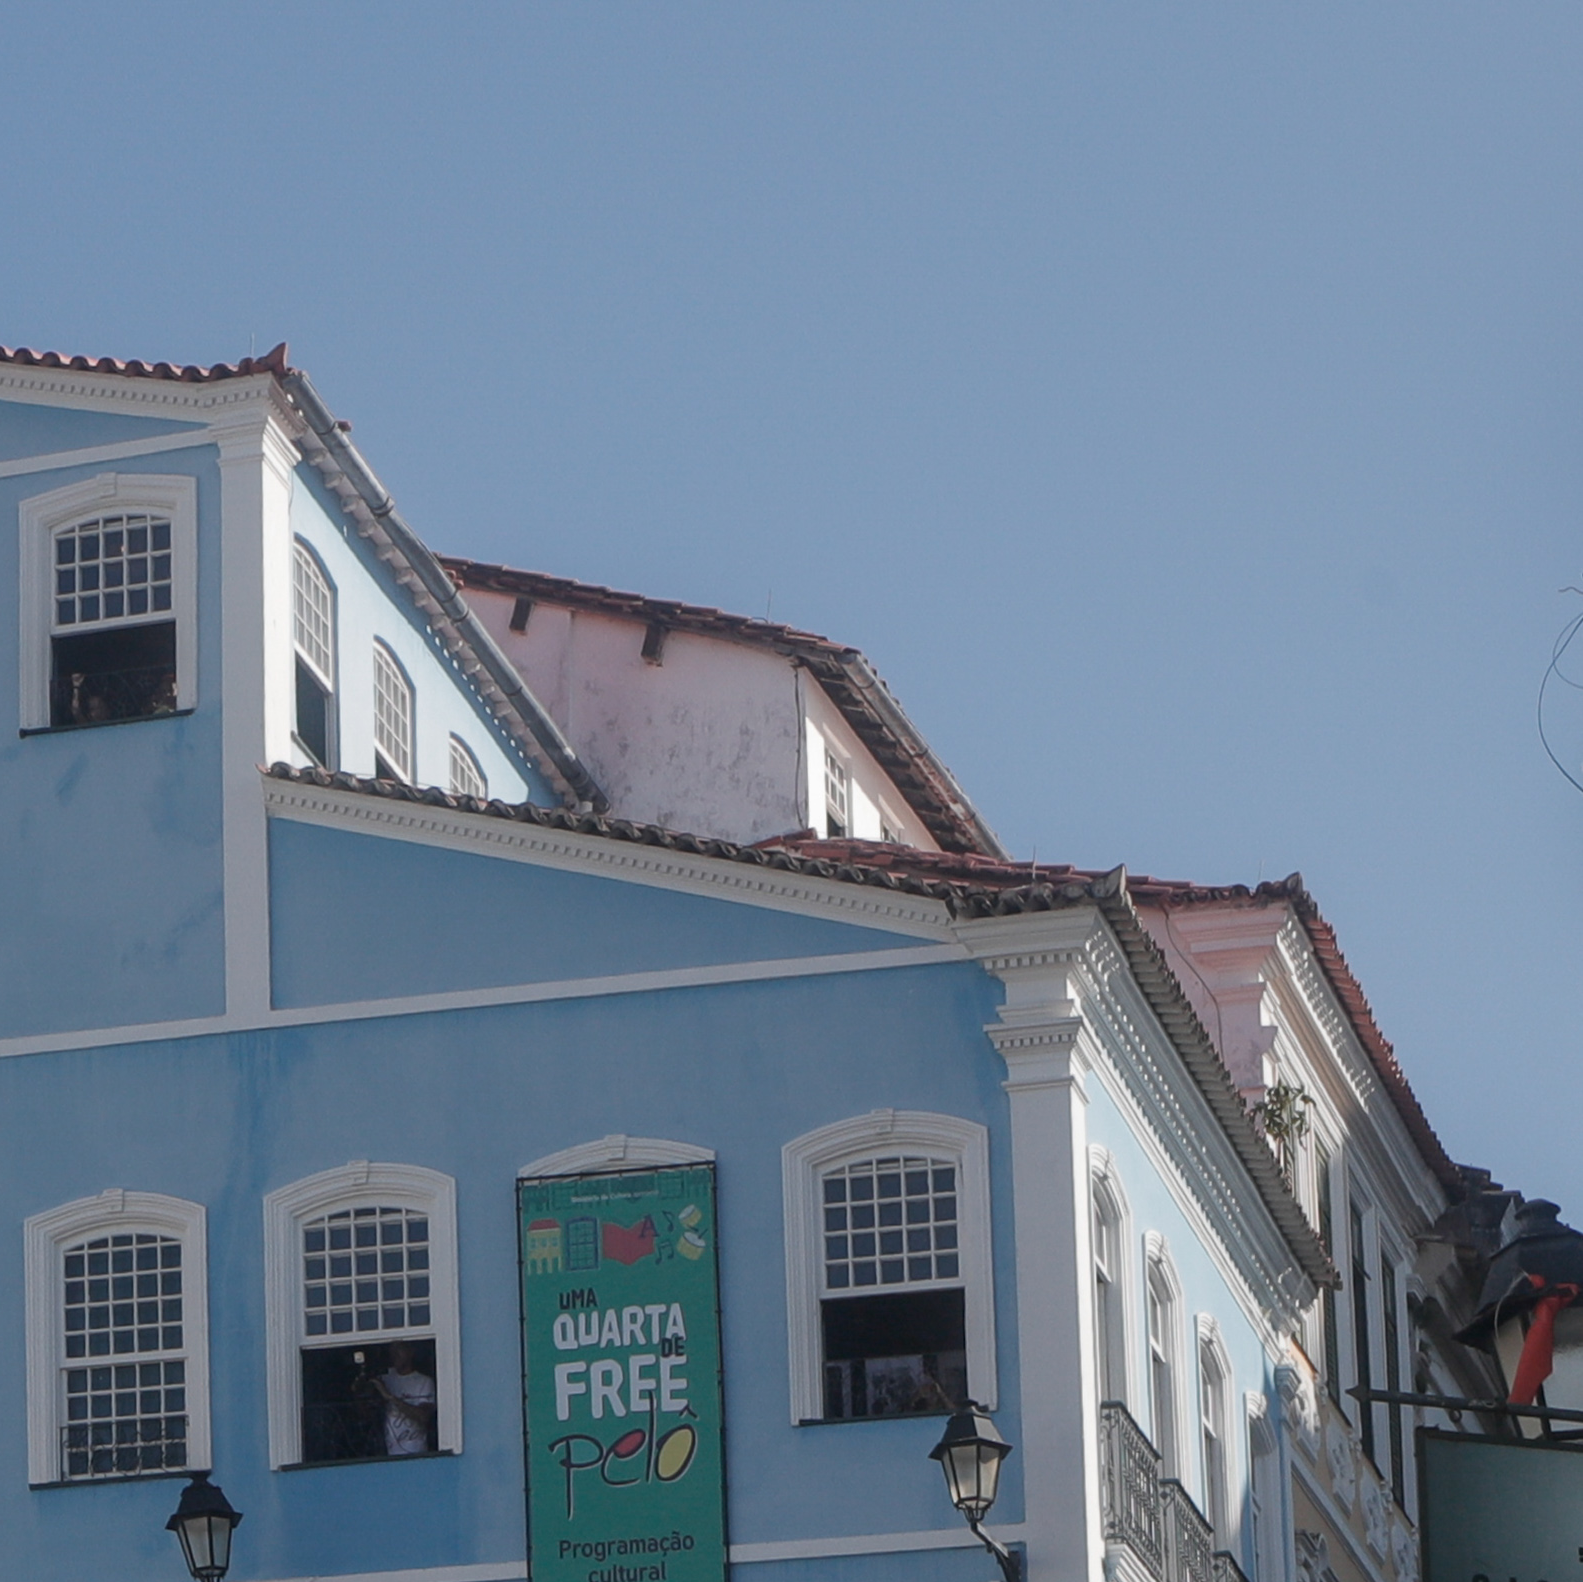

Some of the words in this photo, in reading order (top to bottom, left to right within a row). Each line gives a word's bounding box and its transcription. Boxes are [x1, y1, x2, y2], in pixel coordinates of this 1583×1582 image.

[559, 1287, 598, 1310] UMA
[553, 1302, 687, 1350] QUARTA
[661, 1336, 685, 1358] DE
[554, 1353, 688, 1421] FREE
[558, 1530, 695, 1562] Programação
